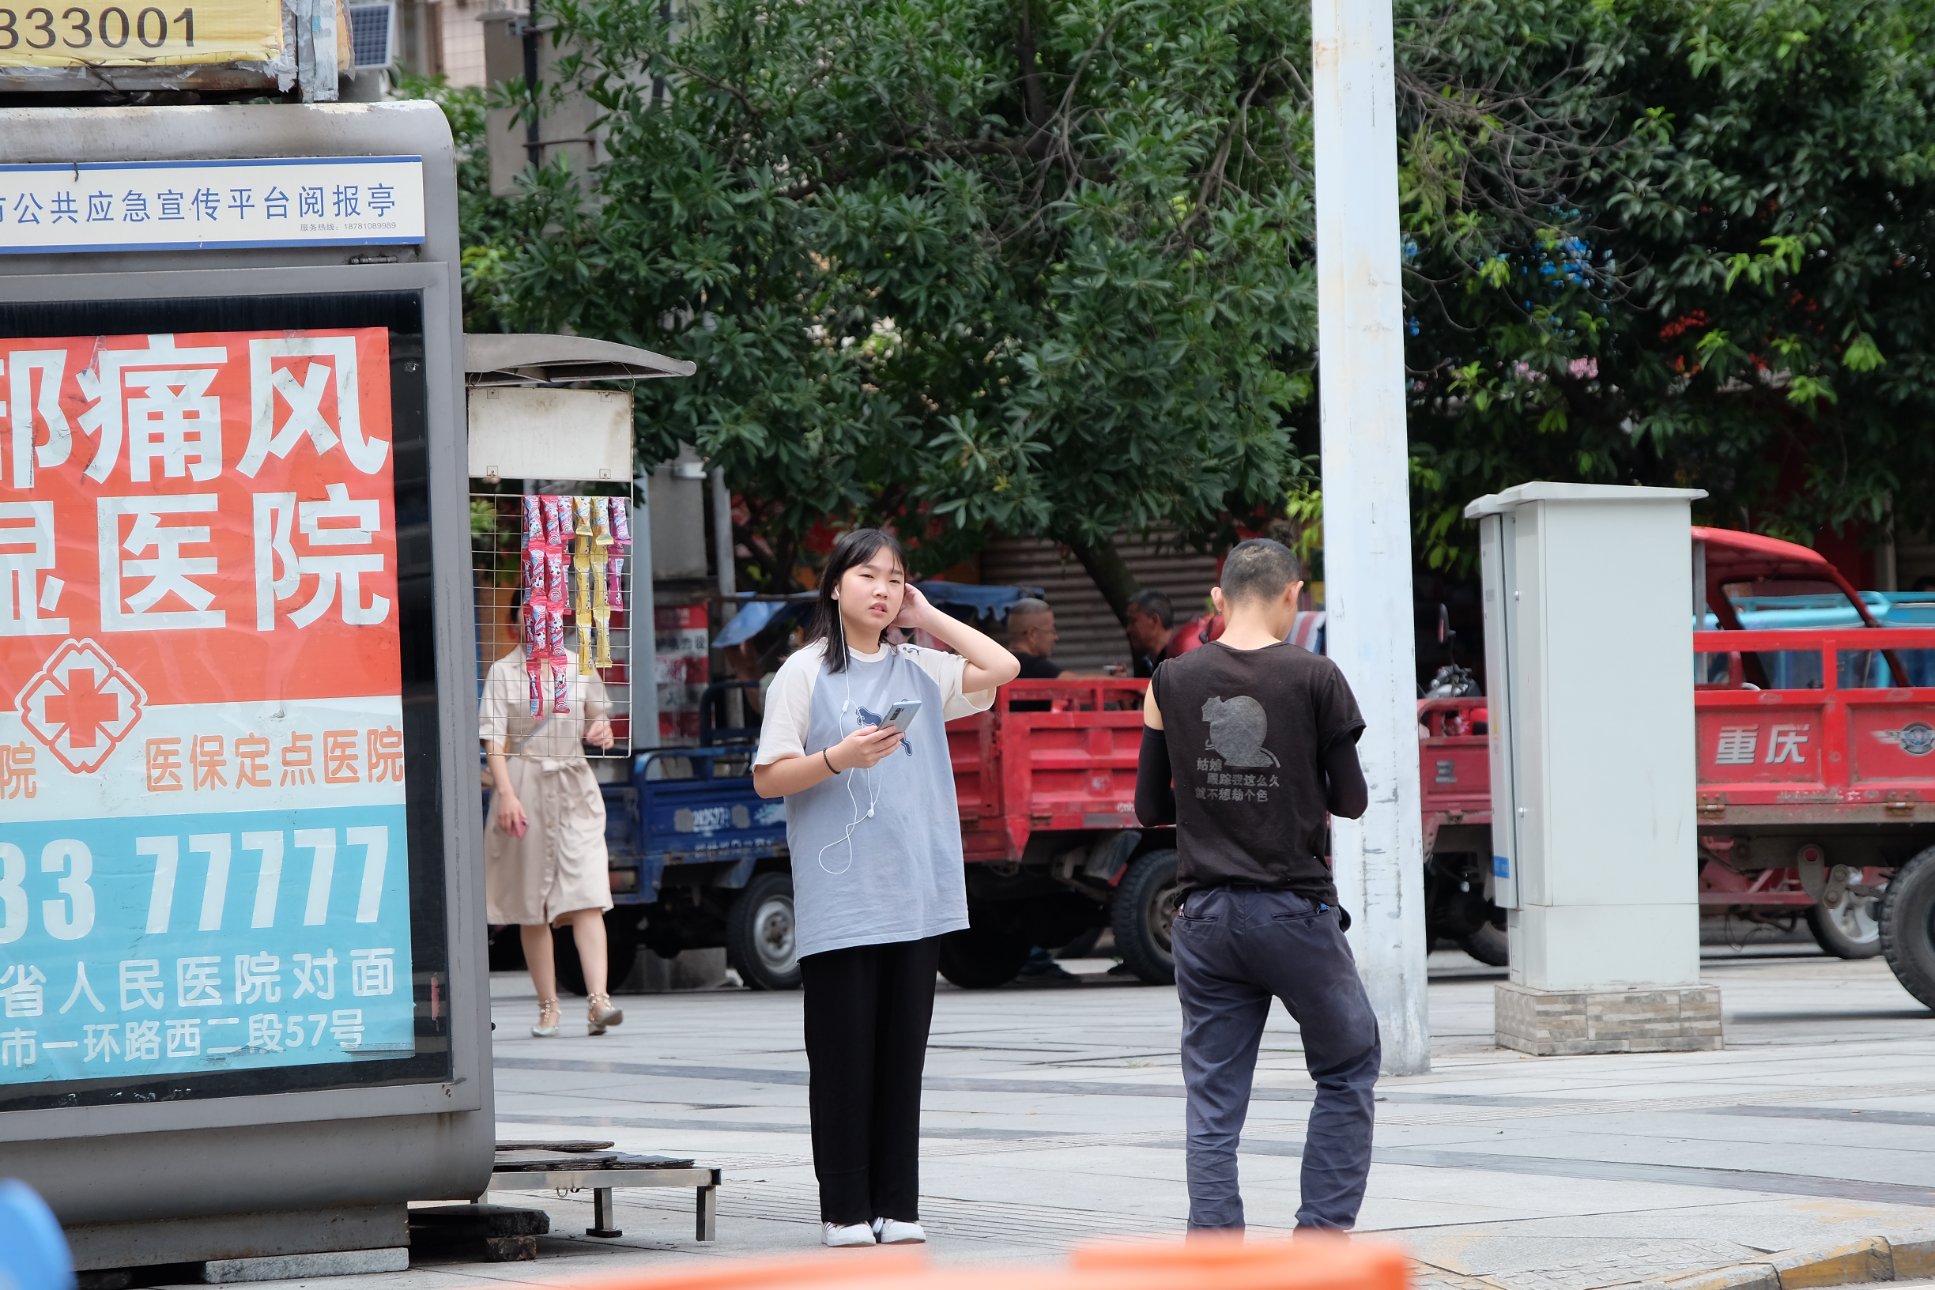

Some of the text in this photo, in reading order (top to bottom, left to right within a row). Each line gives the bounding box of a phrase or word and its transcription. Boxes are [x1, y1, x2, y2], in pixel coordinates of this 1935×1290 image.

[0, 182, 396, 225] 公共应急宣传平台阅报亭
[145, 725, 404, 792] 医保定点医院
[1715, 724, 1810, 765] 重庆
[135, 826, 388, 934] 77777
[0, 948, 396, 1018] 省人民医院对面
[1, 1009, 365, 1068] 市一环路西二段57号
